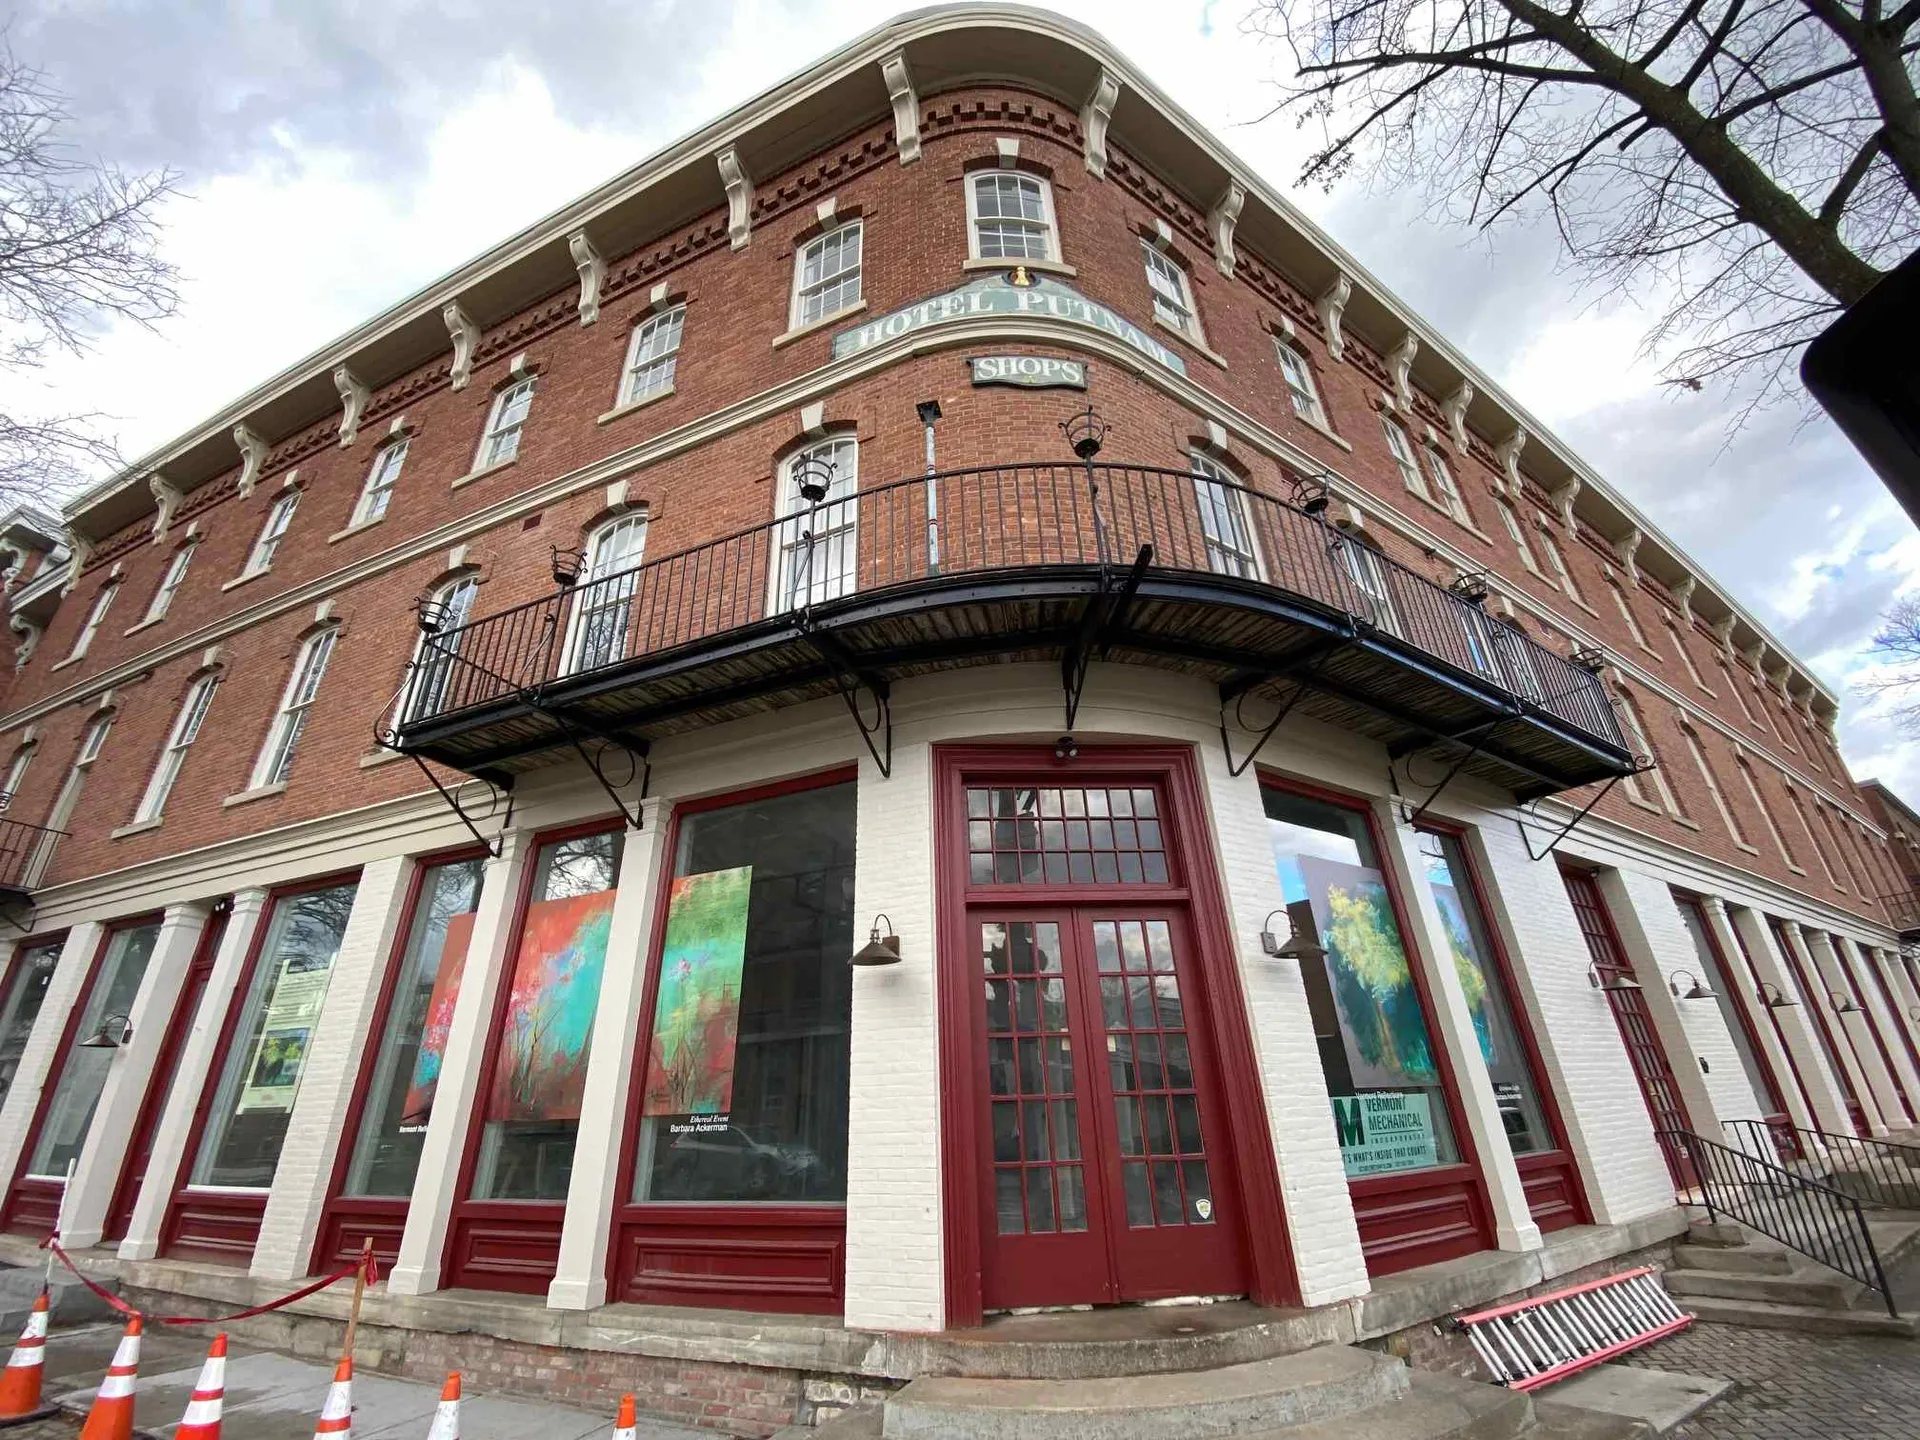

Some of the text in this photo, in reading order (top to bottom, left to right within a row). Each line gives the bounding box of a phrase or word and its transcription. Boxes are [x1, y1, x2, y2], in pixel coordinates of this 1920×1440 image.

[857, 289, 1166, 366] HOTEL PUTNAM
[977, 357, 1080, 382] SHOPS
[1365, 1097, 1406, 1112] VERMONT
[670, 1123, 728, 1132] Barbara Ackerman
[1369, 1113, 1423, 1131] MECHANICAL
[1353, 1151, 1373, 1163] WHAT'S
[1374, 1148, 1393, 1161] INSIDE
[1394, 1147, 1407, 1158] THAT
[1407, 1145, 1427, 1157] COUNTS
